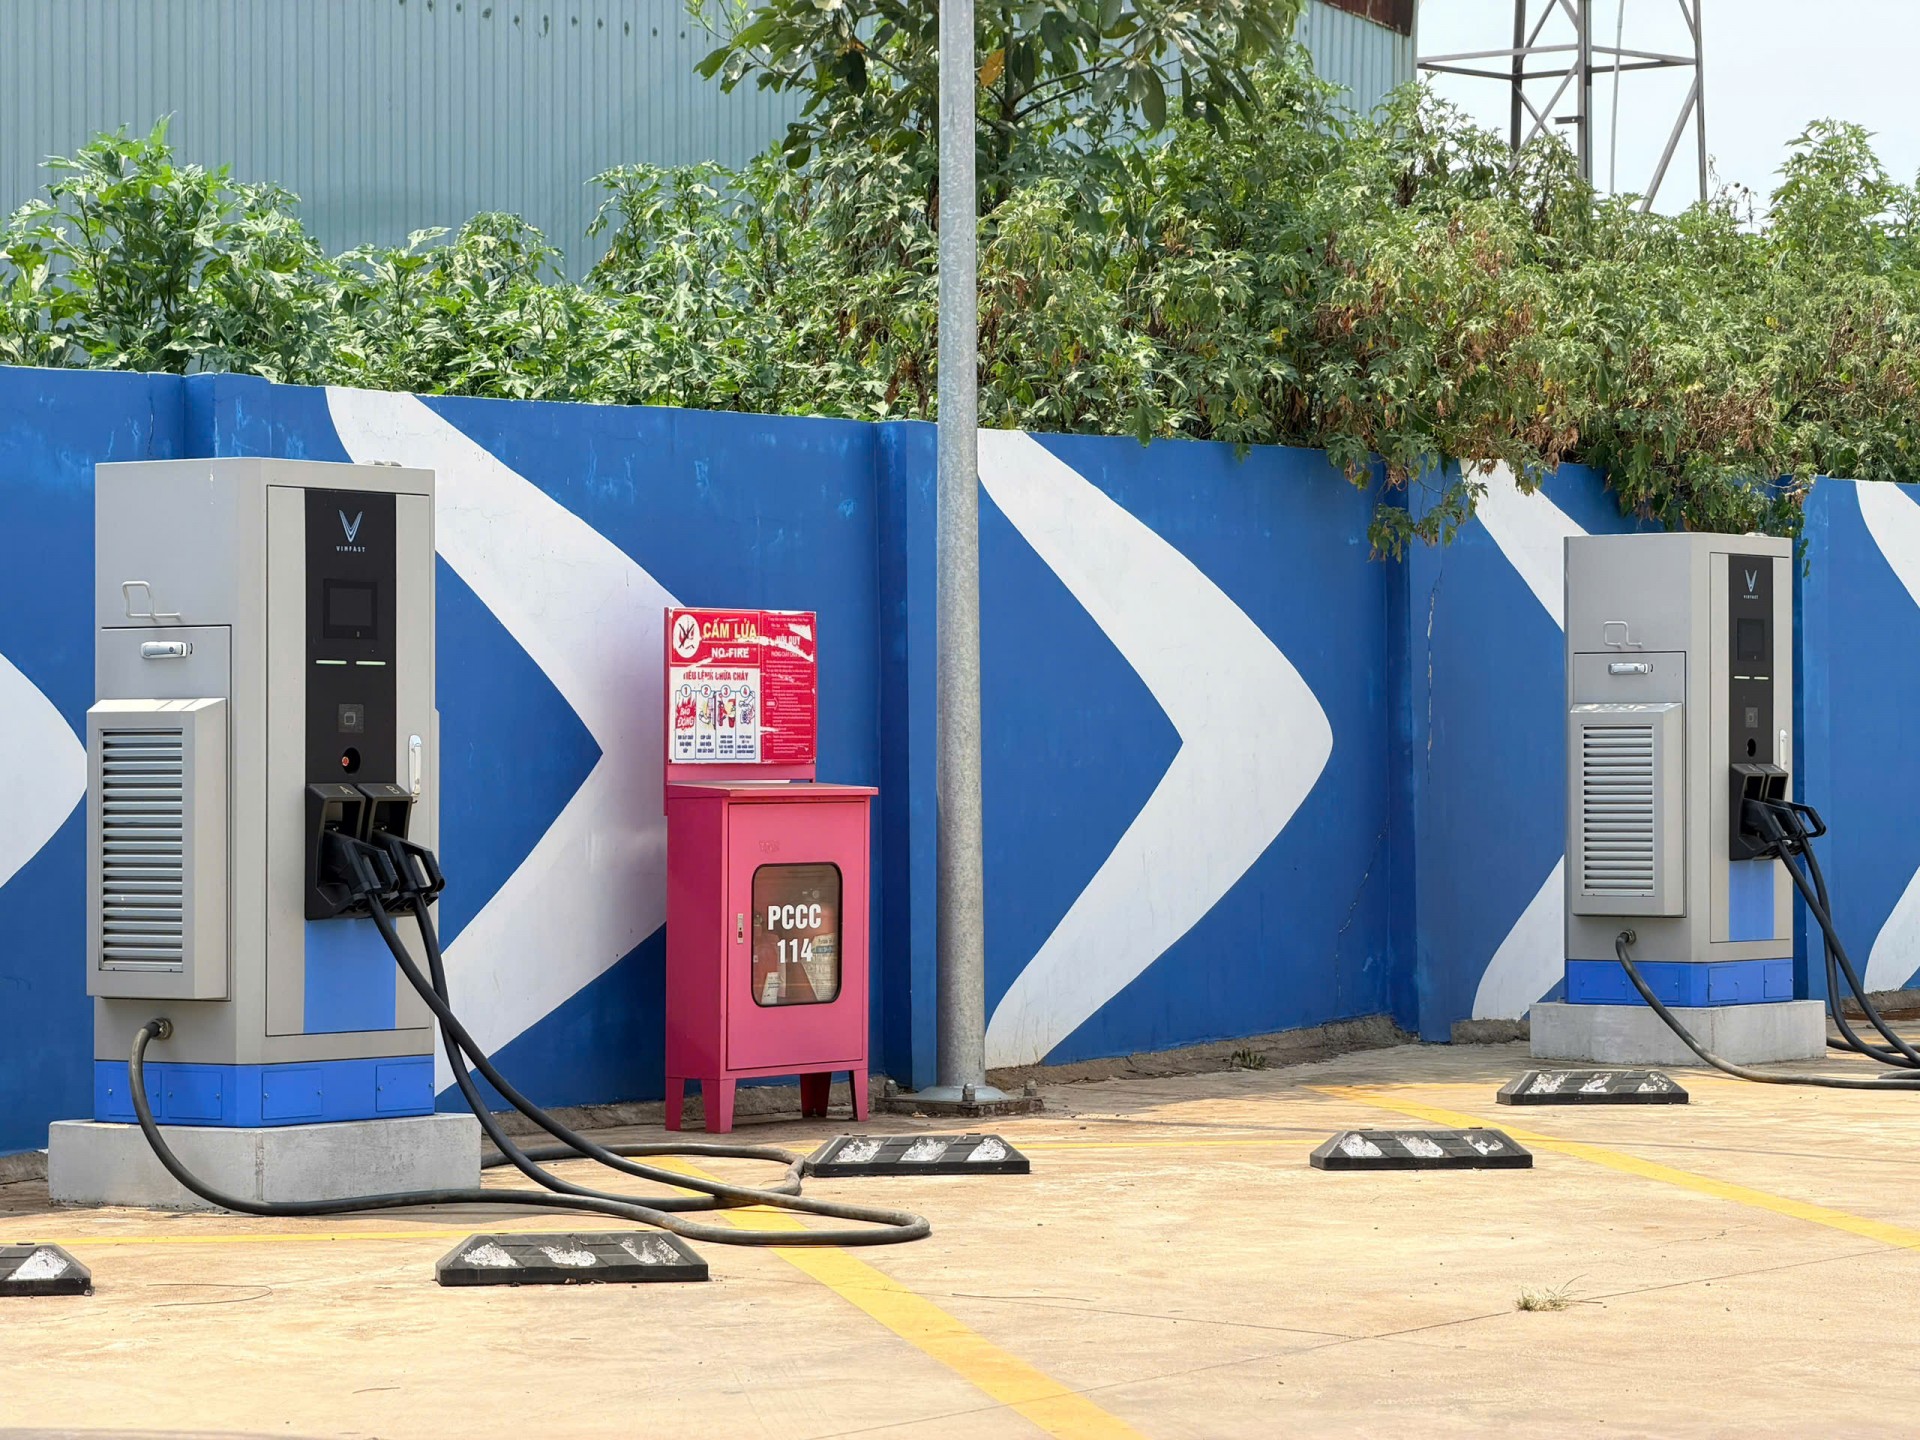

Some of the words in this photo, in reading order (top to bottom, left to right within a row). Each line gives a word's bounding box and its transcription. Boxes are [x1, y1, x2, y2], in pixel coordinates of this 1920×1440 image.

[335, 545, 366, 553] VINFAST
[702, 617, 730, 639] CẤM
[703, 687, 709, 695] 2
[723, 687, 729, 695] 3
[339, 785, 354, 795] A
[767, 903, 822, 931] PCCC
[776, 938, 814, 964] 114
